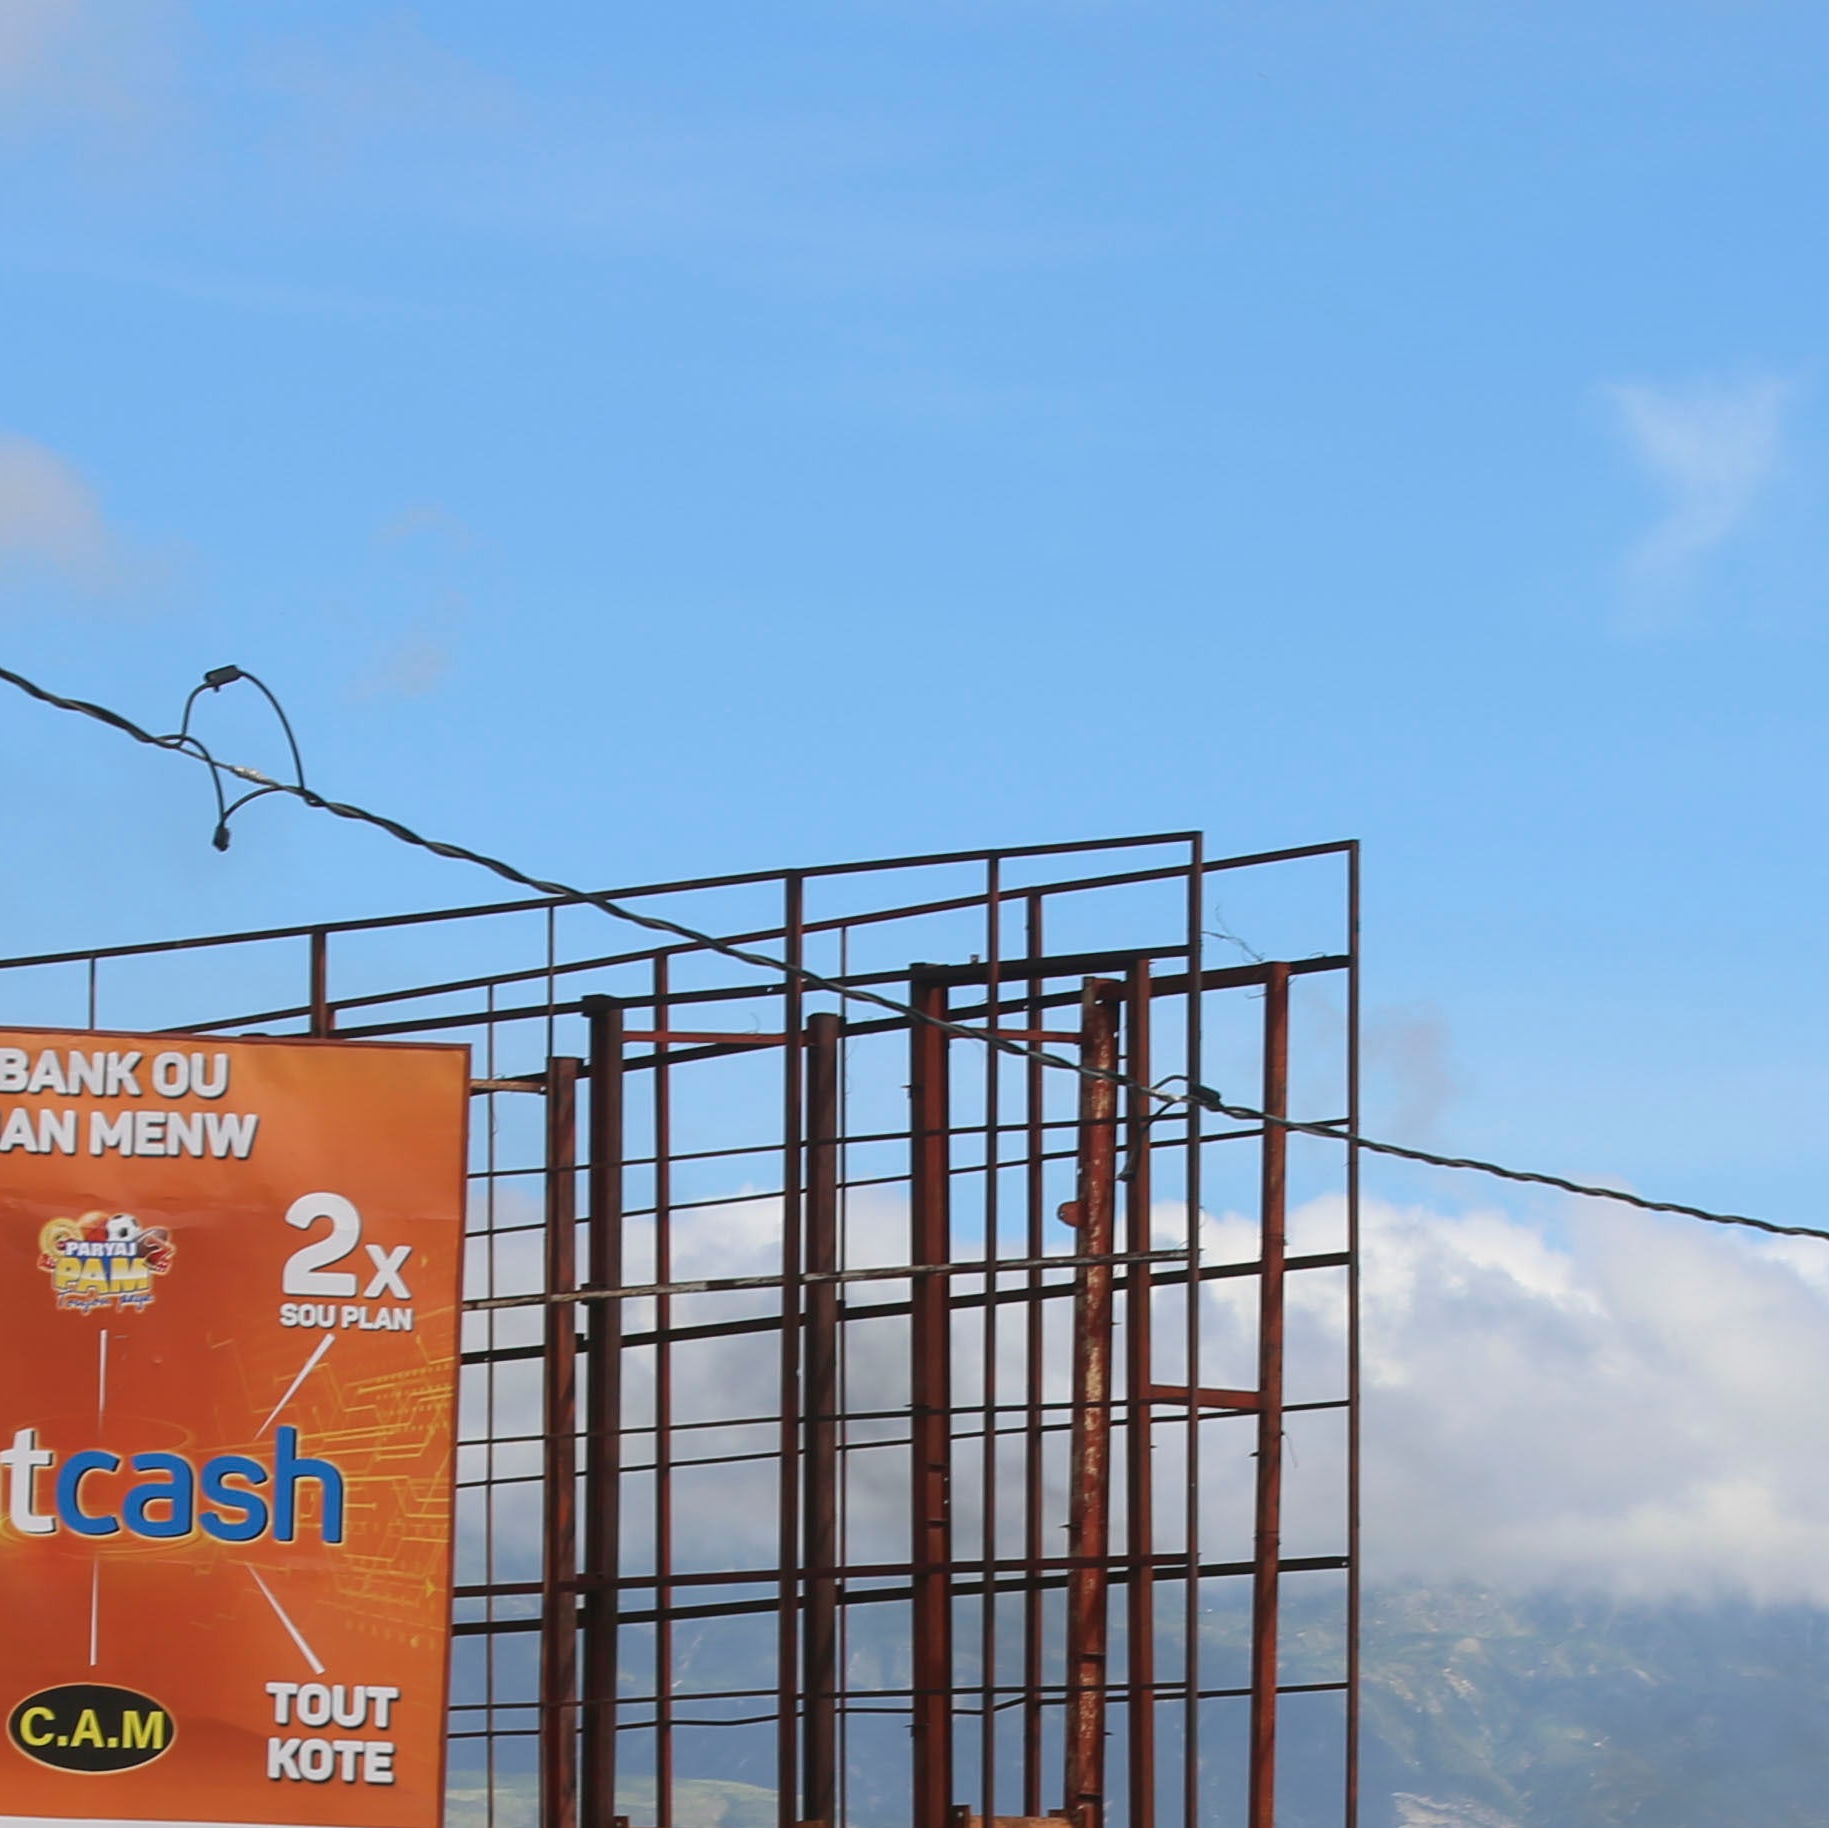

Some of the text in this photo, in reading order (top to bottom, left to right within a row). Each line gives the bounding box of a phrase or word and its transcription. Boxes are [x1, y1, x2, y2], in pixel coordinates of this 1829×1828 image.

[152, 1051, 229, 1099] OU
[89, 1109, 260, 1159] MENW
[65, 1241, 138, 1257] PARYAJ
[54, 1256, 150, 1293] PAM
[279, 1302, 414, 1332] SOU PLAN
[19, 1706, 165, 1750] C.A.M
[265, 1681, 401, 1729] TOUT
[267, 1736, 396, 1785] KOTE
